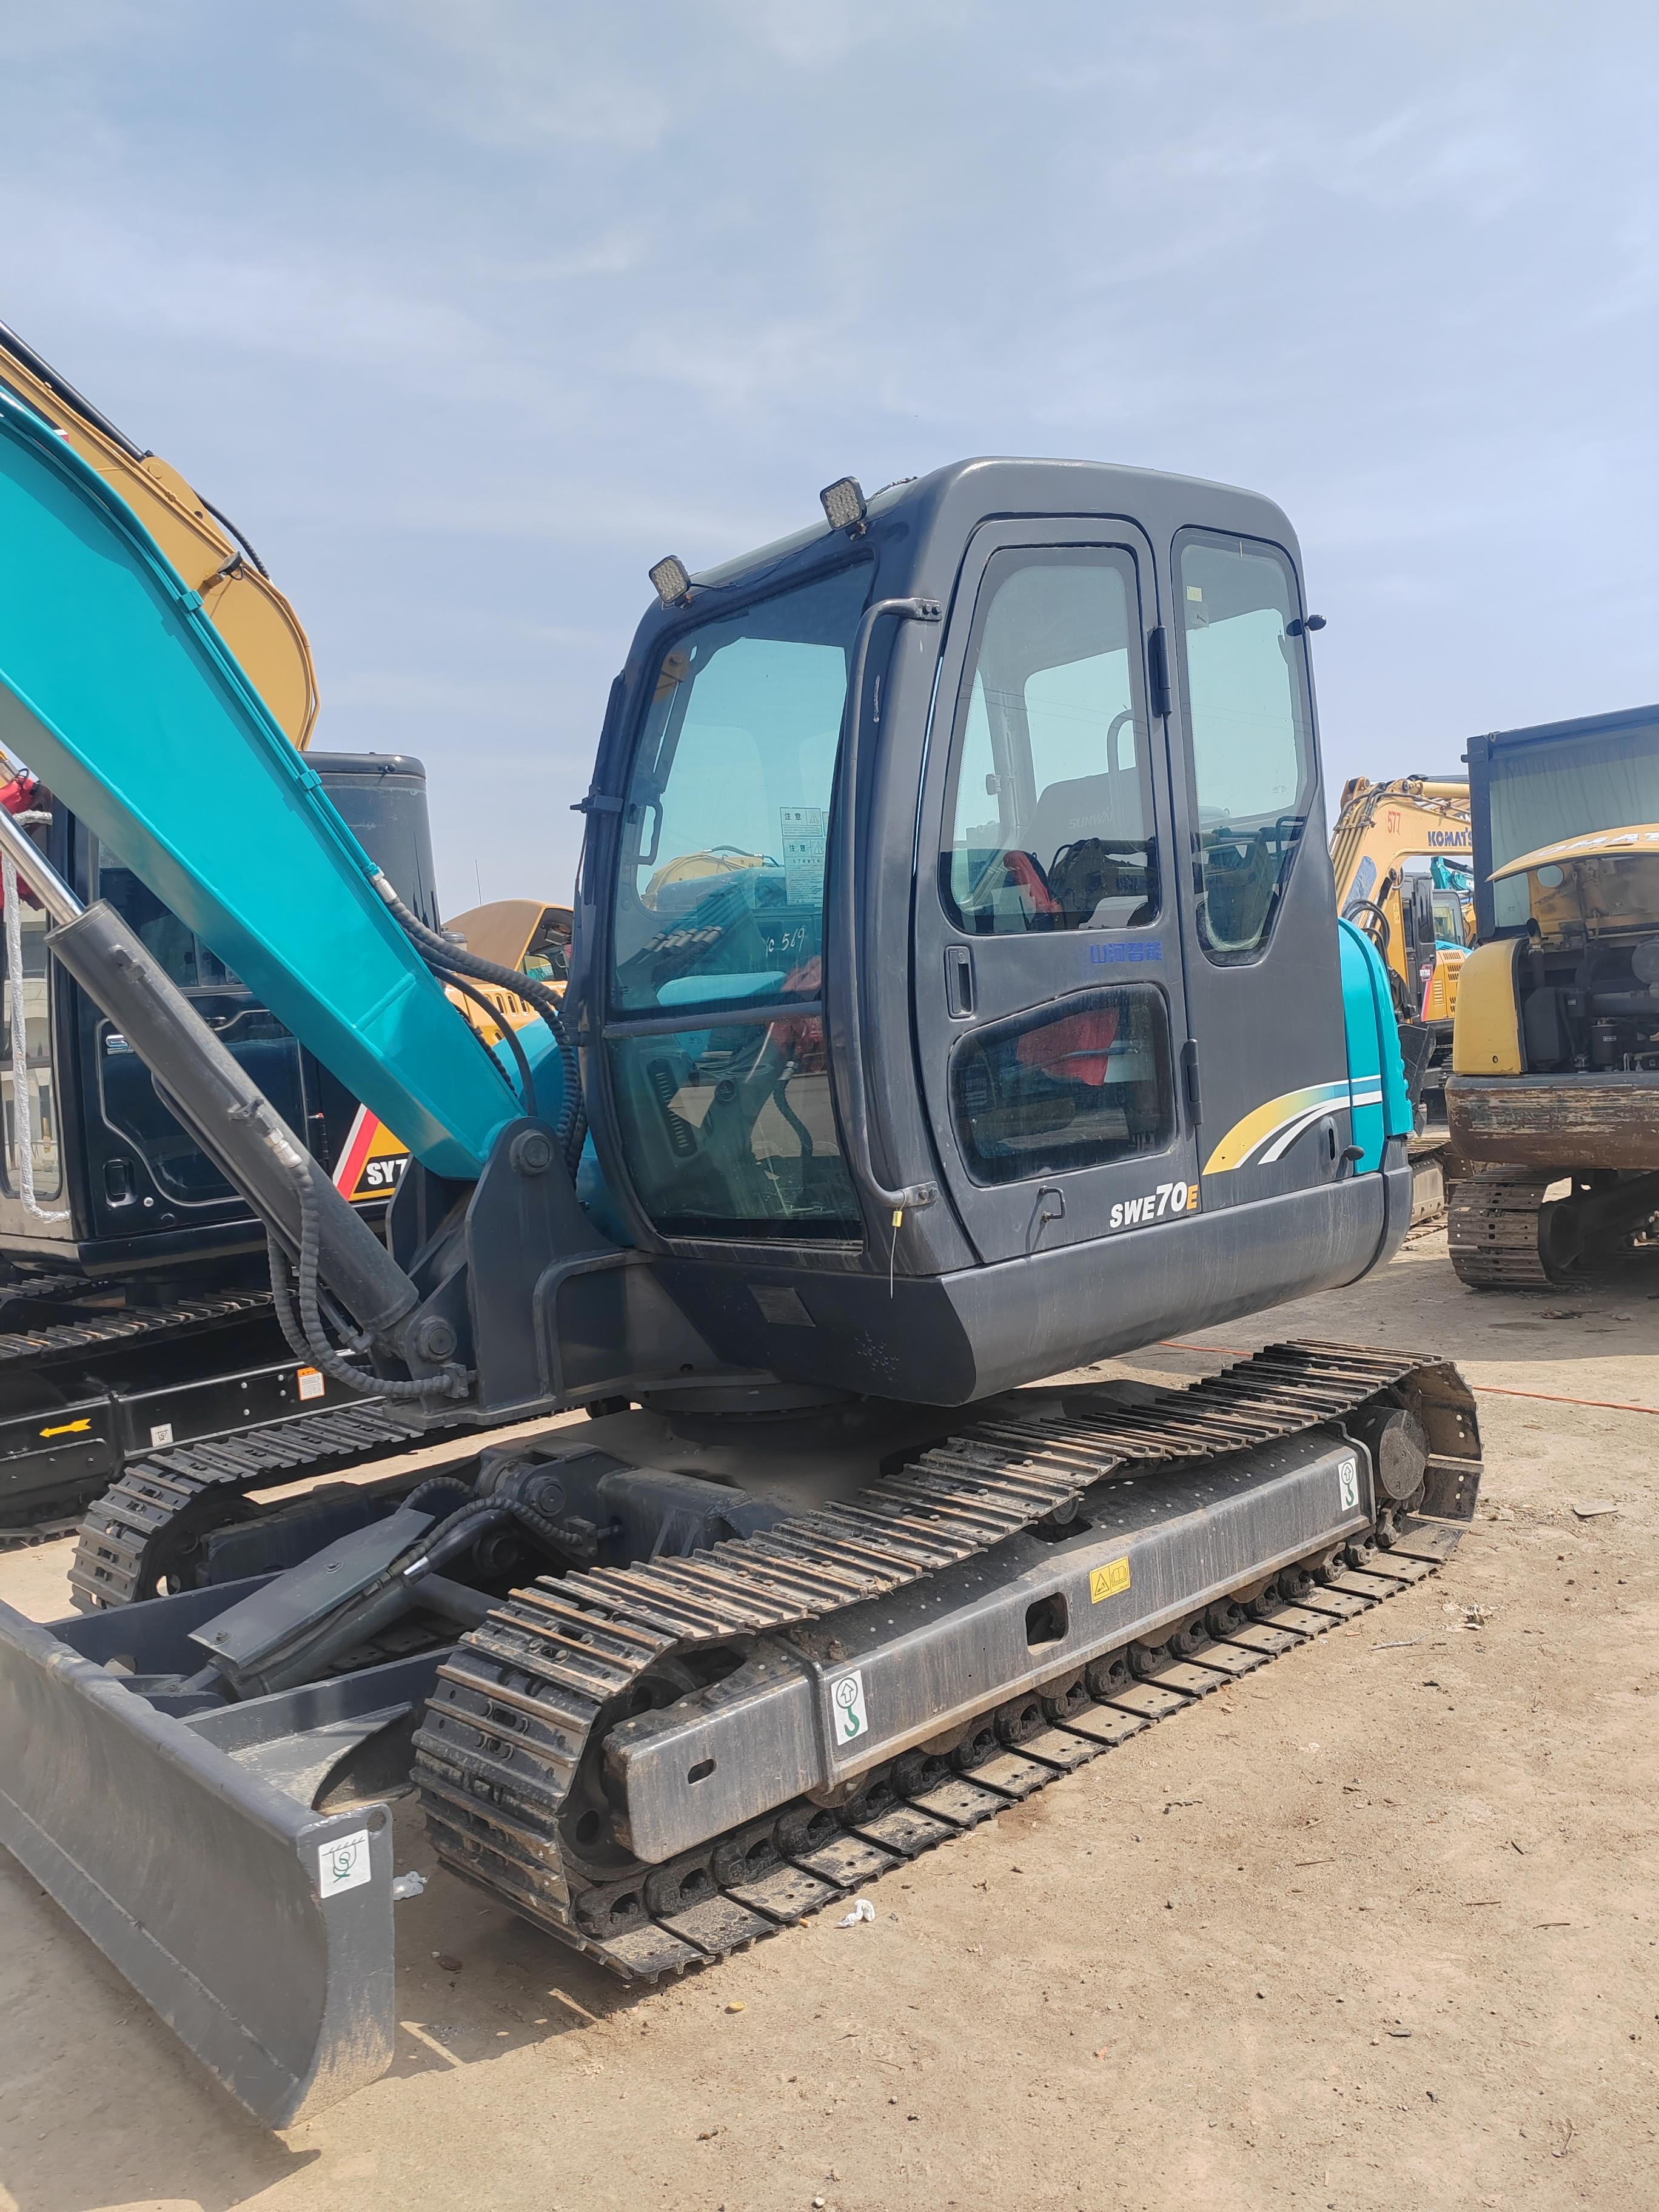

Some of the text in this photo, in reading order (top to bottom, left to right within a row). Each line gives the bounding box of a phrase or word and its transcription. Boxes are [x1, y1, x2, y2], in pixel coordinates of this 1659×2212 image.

[785, 812, 802, 820] 注意
[1090, 941, 1162, 964] 山河智能
[1110, 1181, 1198, 1228] SWE70E
